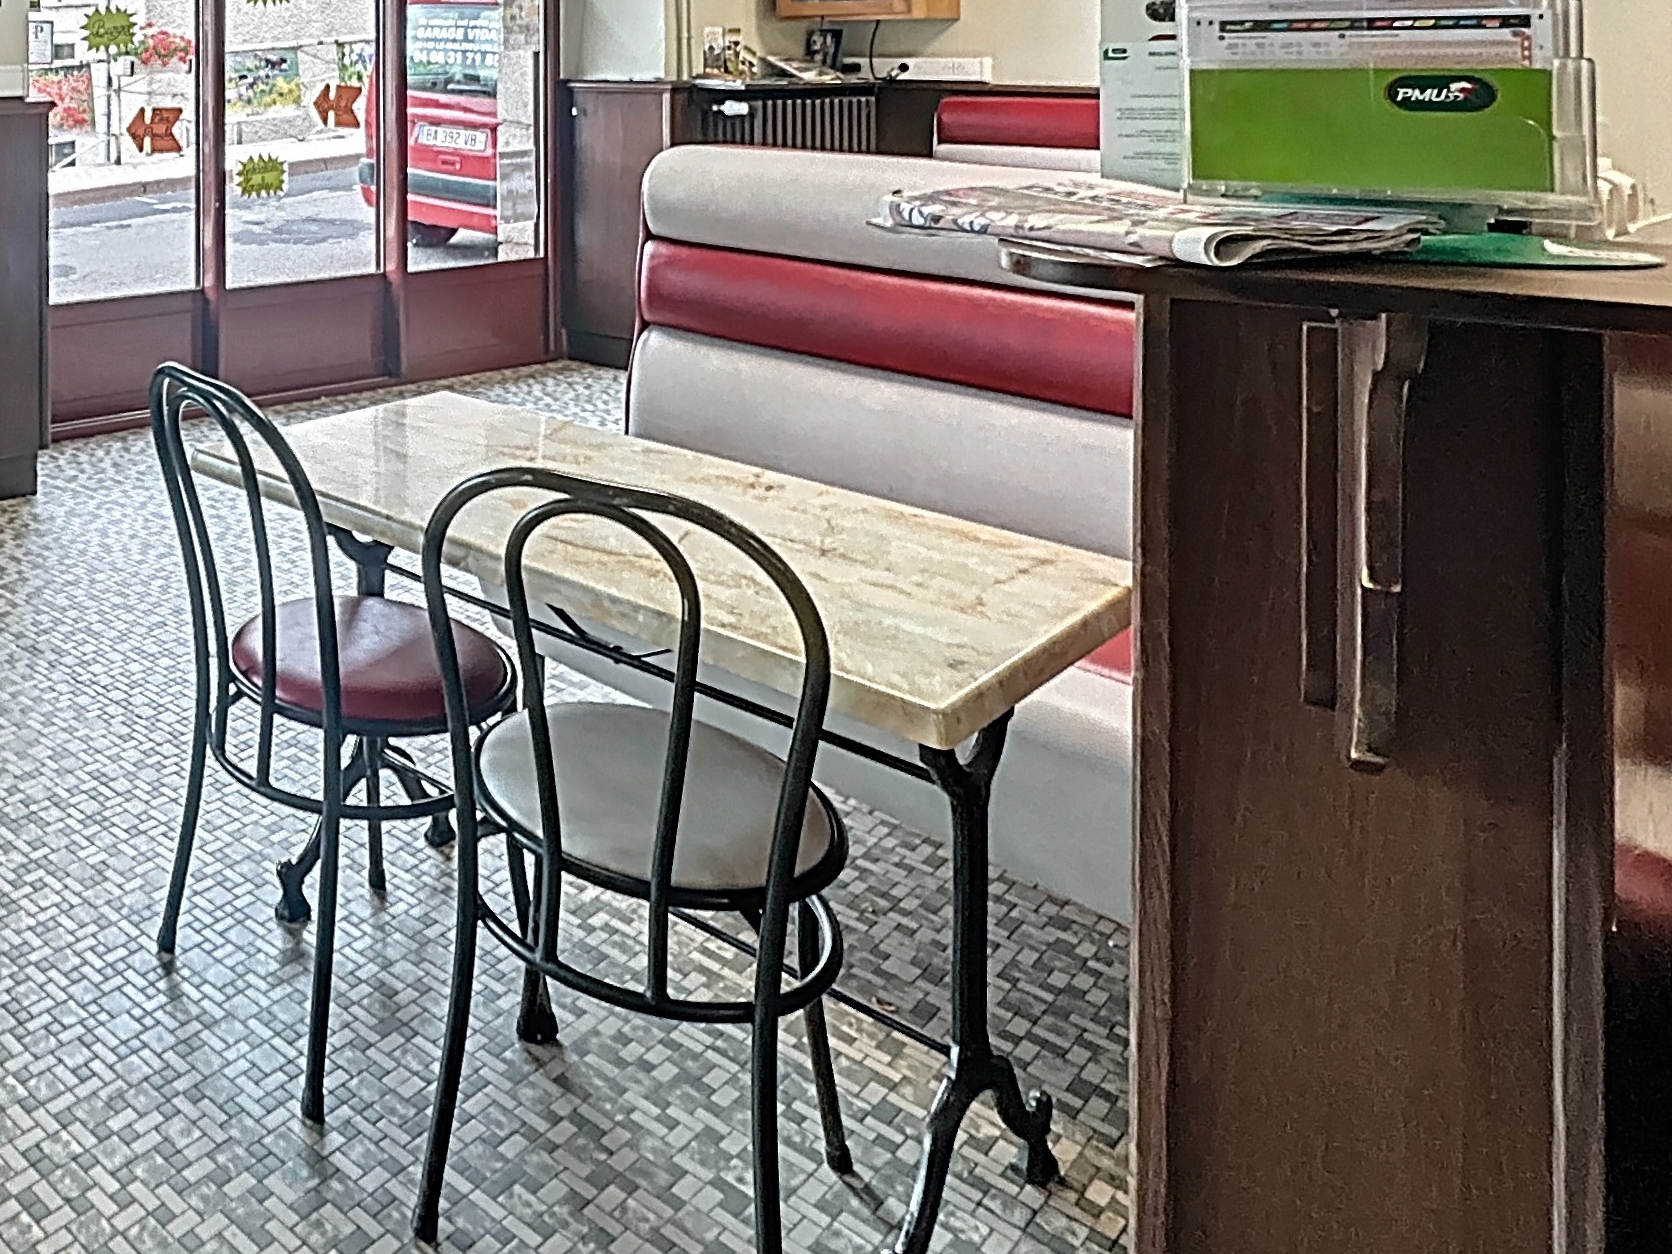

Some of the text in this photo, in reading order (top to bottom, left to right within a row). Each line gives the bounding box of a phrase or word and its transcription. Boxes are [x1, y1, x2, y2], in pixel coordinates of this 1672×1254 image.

[416, 27, 464, 40] GARAGE
[446, 51, 462, 65] 31
[465, 52, 482, 66] 71
[1396, 87, 1448, 102] PMU
[440, 130, 461, 145] 392
